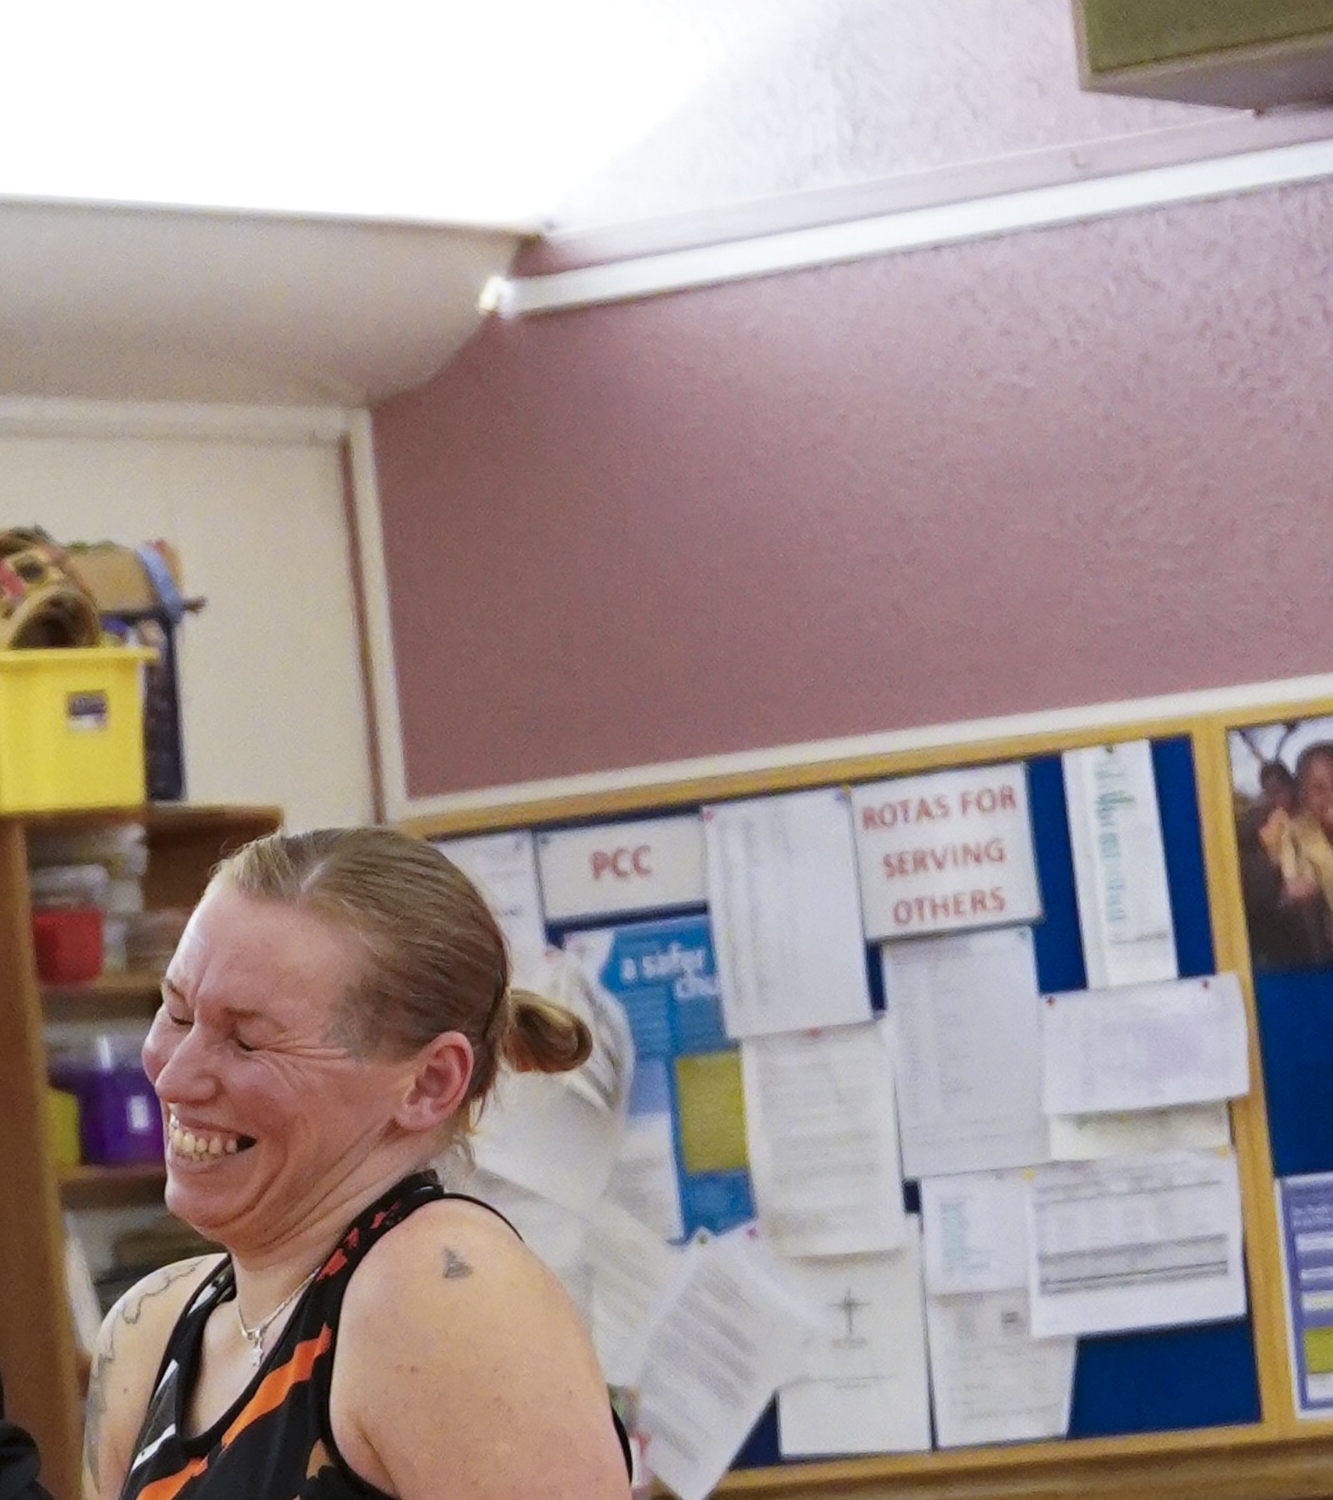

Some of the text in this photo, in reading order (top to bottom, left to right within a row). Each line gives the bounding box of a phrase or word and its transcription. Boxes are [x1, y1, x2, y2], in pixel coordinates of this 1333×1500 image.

[862, 785, 1017, 830] ROTAS FOR
[589, 845, 652, 880] PCC
[883, 838, 1006, 878] SERVING
[893, 887, 1006, 925] OTHERS
